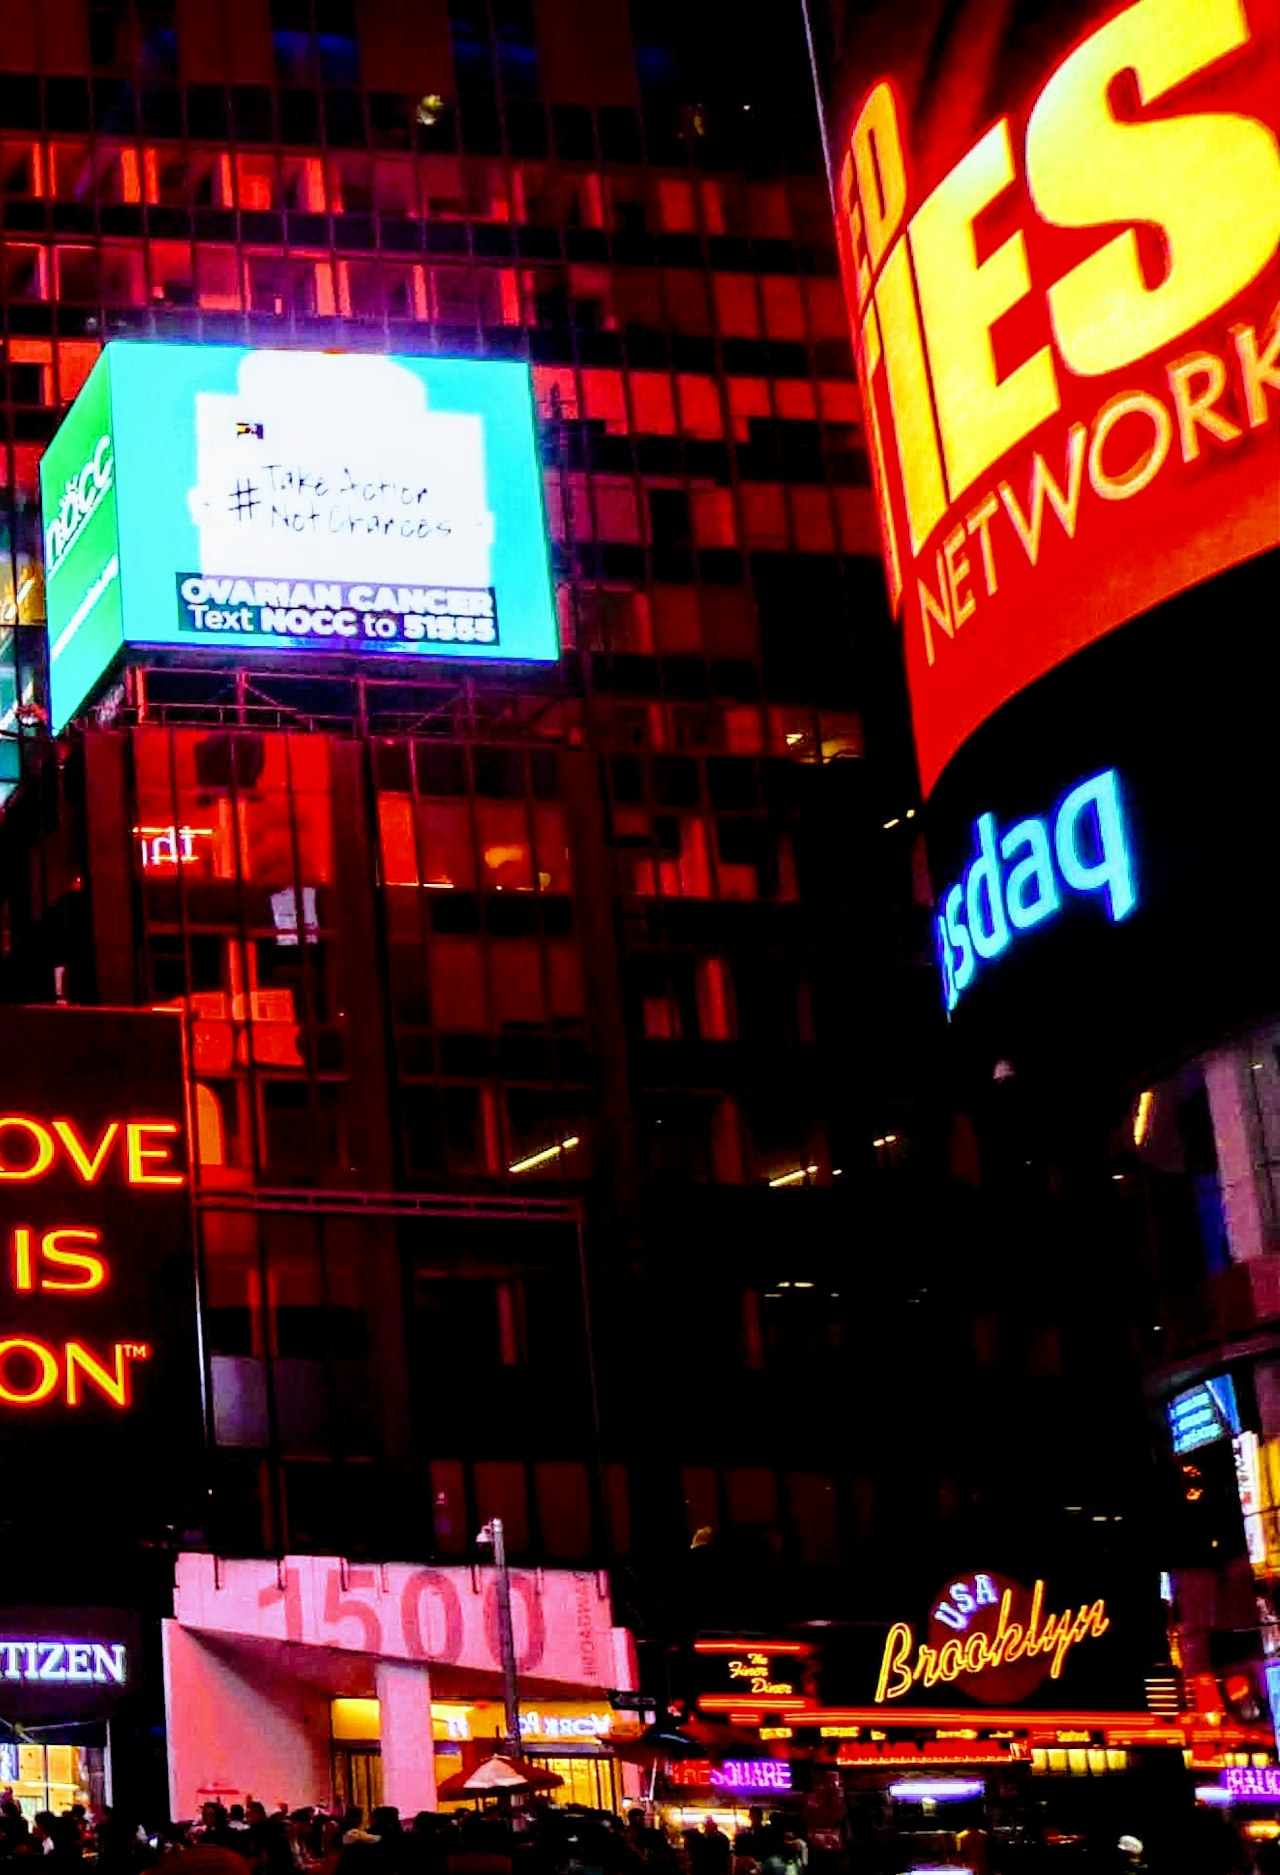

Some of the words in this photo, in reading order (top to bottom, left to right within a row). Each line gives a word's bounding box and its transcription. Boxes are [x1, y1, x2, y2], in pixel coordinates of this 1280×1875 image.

[180, 577, 342, 609] OVARIAN
[348, 585, 493, 617] CANCER
[187, 604, 254, 632] Text
[261, 606, 358, 637] NOCC
[362, 612, 397, 638] to
[14, 1228, 105, 1290] IS
[257, 1567, 546, 1673] 1500
[933, 1574, 998, 1632] USA
[873, 1578, 1110, 1703] Brooklyn
[751, 1677, 792, 1694] Diner
